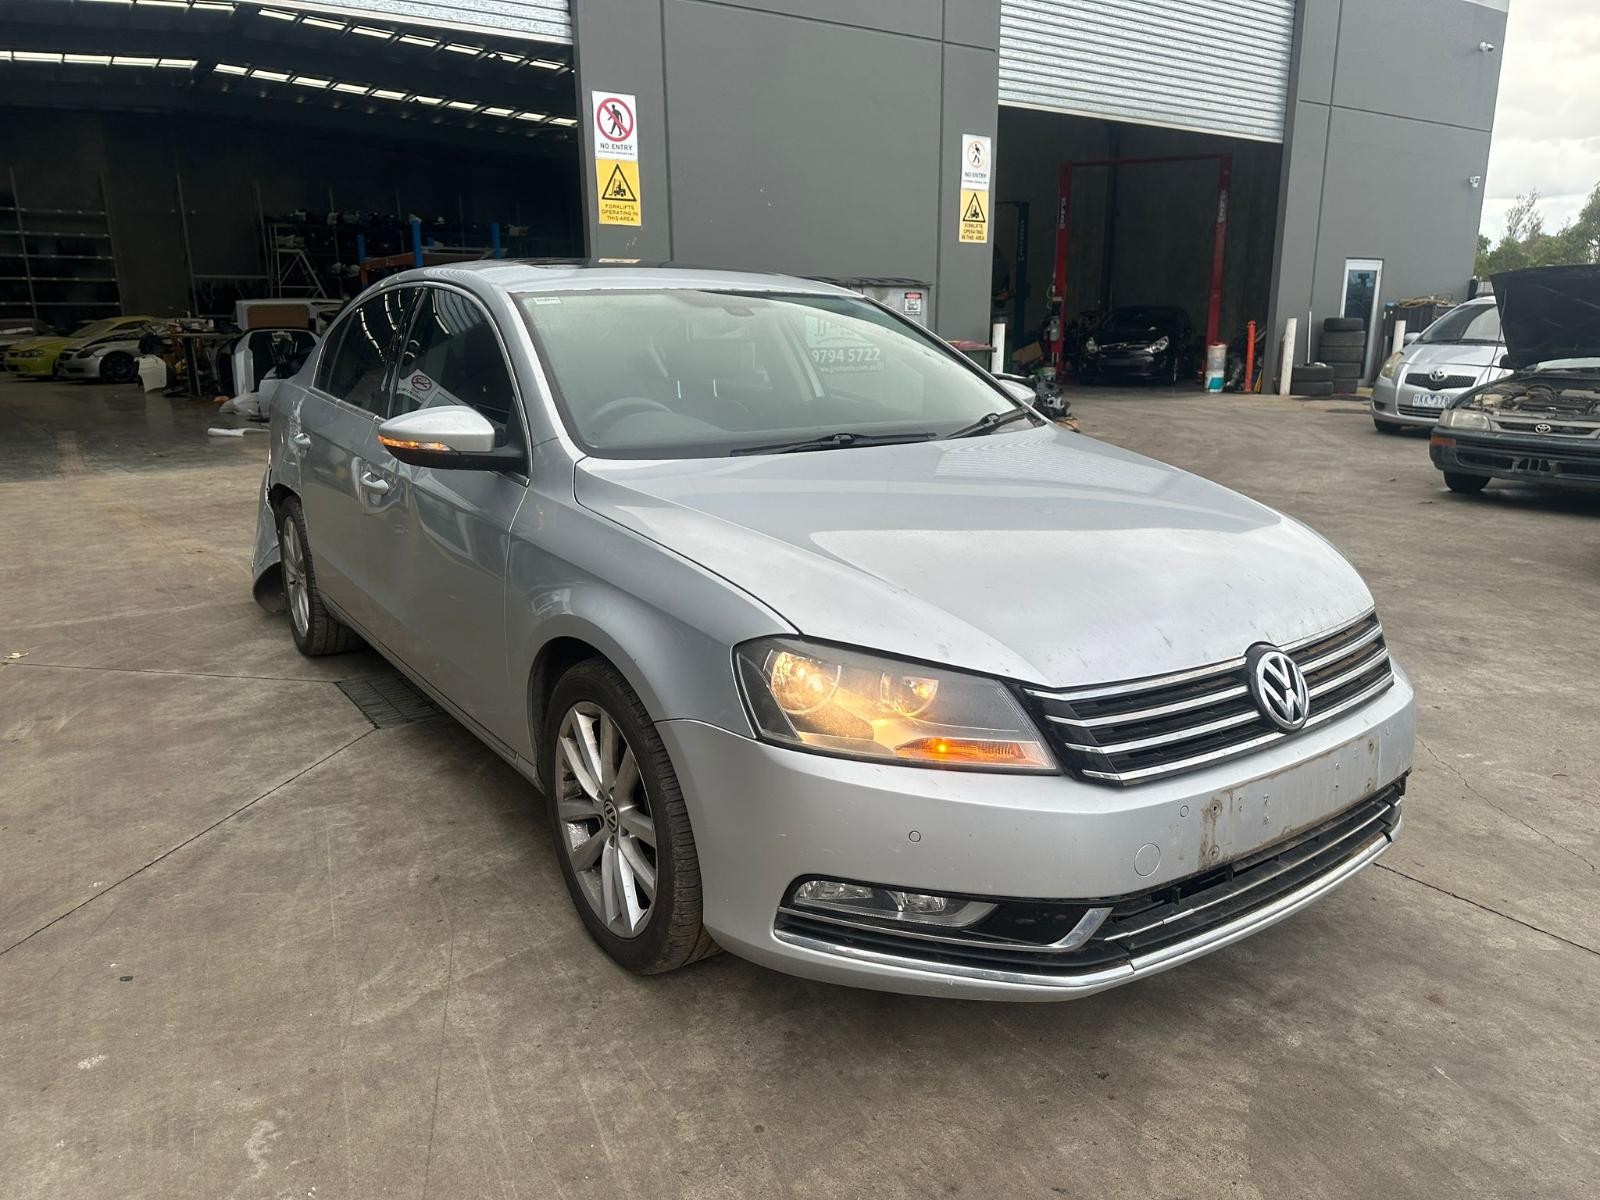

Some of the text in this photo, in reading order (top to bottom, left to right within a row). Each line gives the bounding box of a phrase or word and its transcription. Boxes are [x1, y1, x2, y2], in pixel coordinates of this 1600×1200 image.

[600, 142, 633, 151] NO ENTRY
[812, 347, 881, 363] 9794 5722
[1257, 651, 1308, 729] VW
